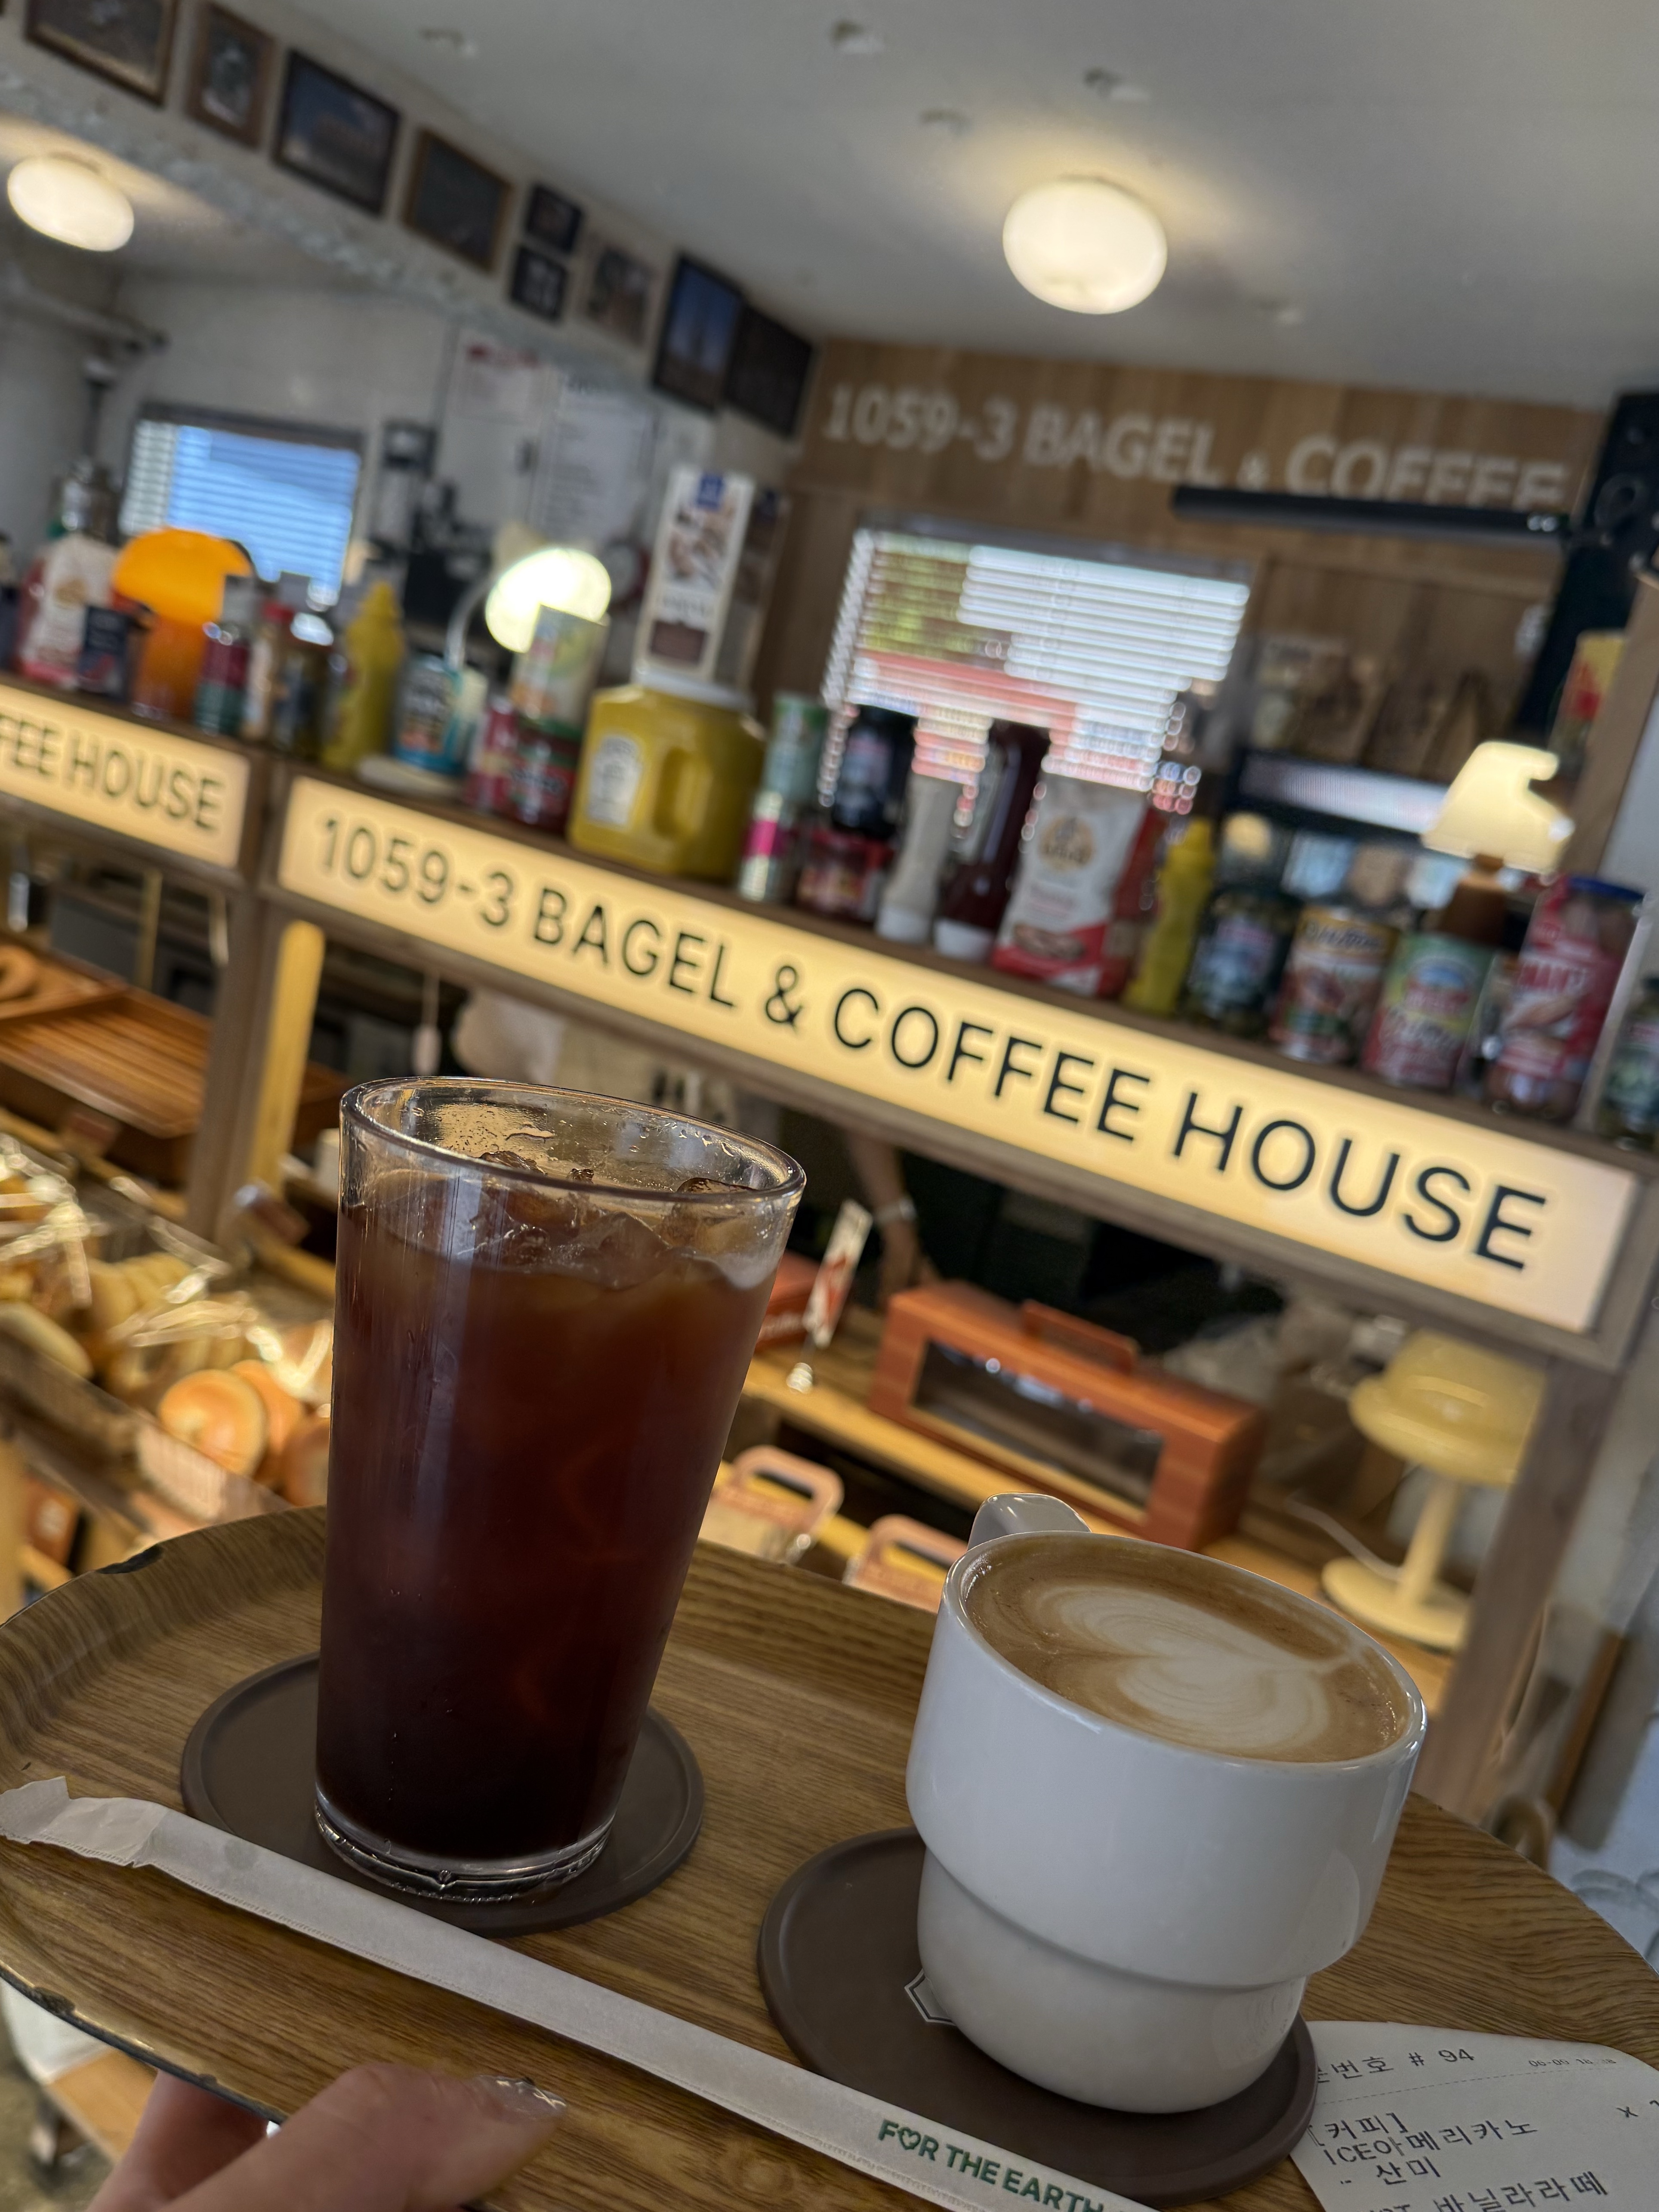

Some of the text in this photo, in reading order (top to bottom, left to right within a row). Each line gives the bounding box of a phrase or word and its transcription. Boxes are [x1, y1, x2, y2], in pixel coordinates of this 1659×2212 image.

[825, 384, 1015, 462] 1059-3
[1024, 404, 1221, 485] BAGEL
[68, 733, 225, 829] HOUSE
[324, 817, 1546, 1270] 1059-3 BAGEL & COFFEE HOUSE
[1409, 2052, 1425, 2066] #
[1438, 2048, 1474, 2062] 94
[1307, 2112, 1408, 2147] [커피]
[1323, 2120, 1538, 2165] ICE아메리카노
[877, 2119, 1104, 2212] FOR THE EARTH
[1376, 2156, 1441, 2185] 산미
